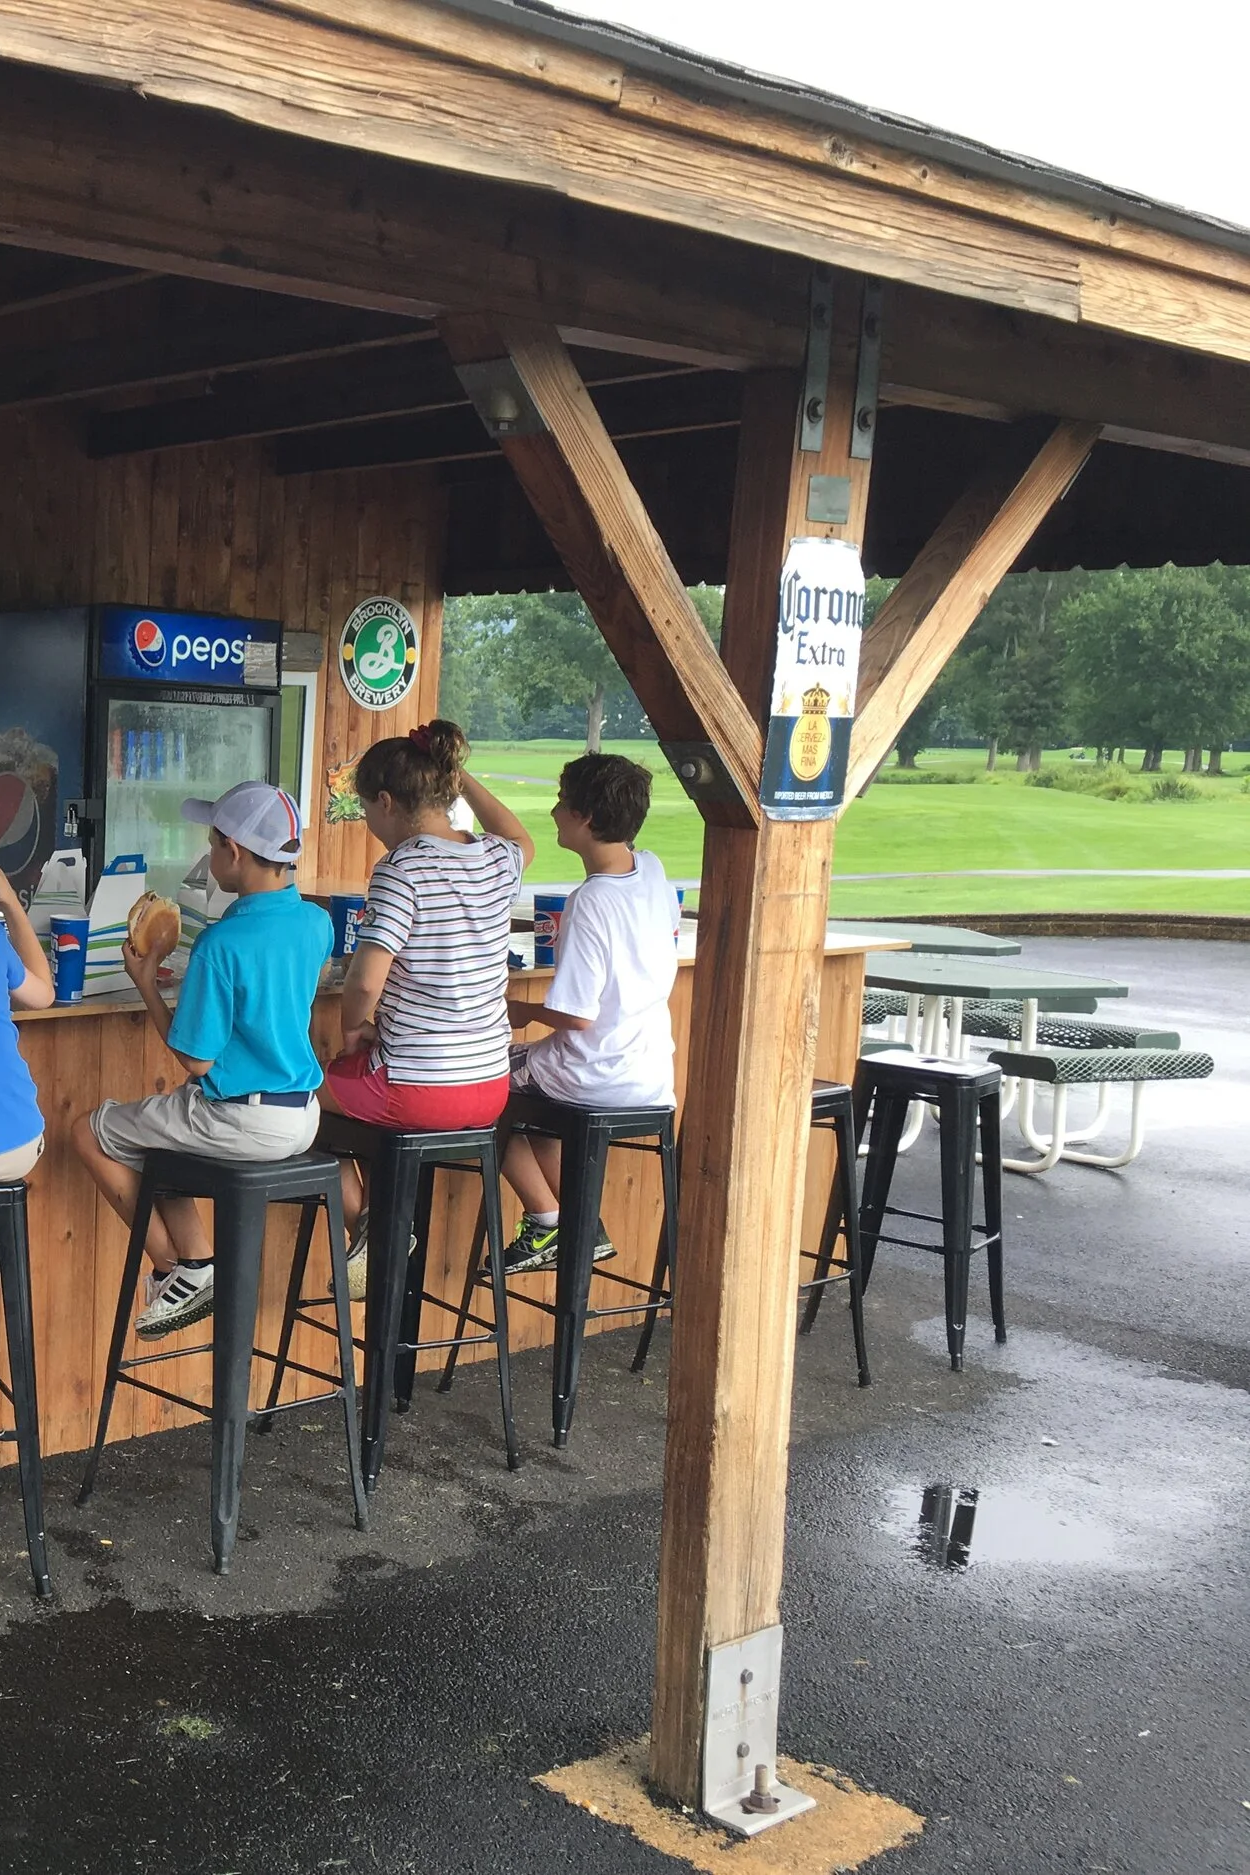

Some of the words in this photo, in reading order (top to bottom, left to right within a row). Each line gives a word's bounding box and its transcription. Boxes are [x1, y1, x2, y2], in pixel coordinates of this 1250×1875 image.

[351, 602, 412, 635] BROOKLYN
[171, 634, 252, 671] peps
[795, 630, 846, 668] Extra
[349, 673, 408, 704] BREWERY
[808, 721, 817, 731] LA
[800, 756, 817, 767] FINA
[343, 908, 359, 954] PEPSI
